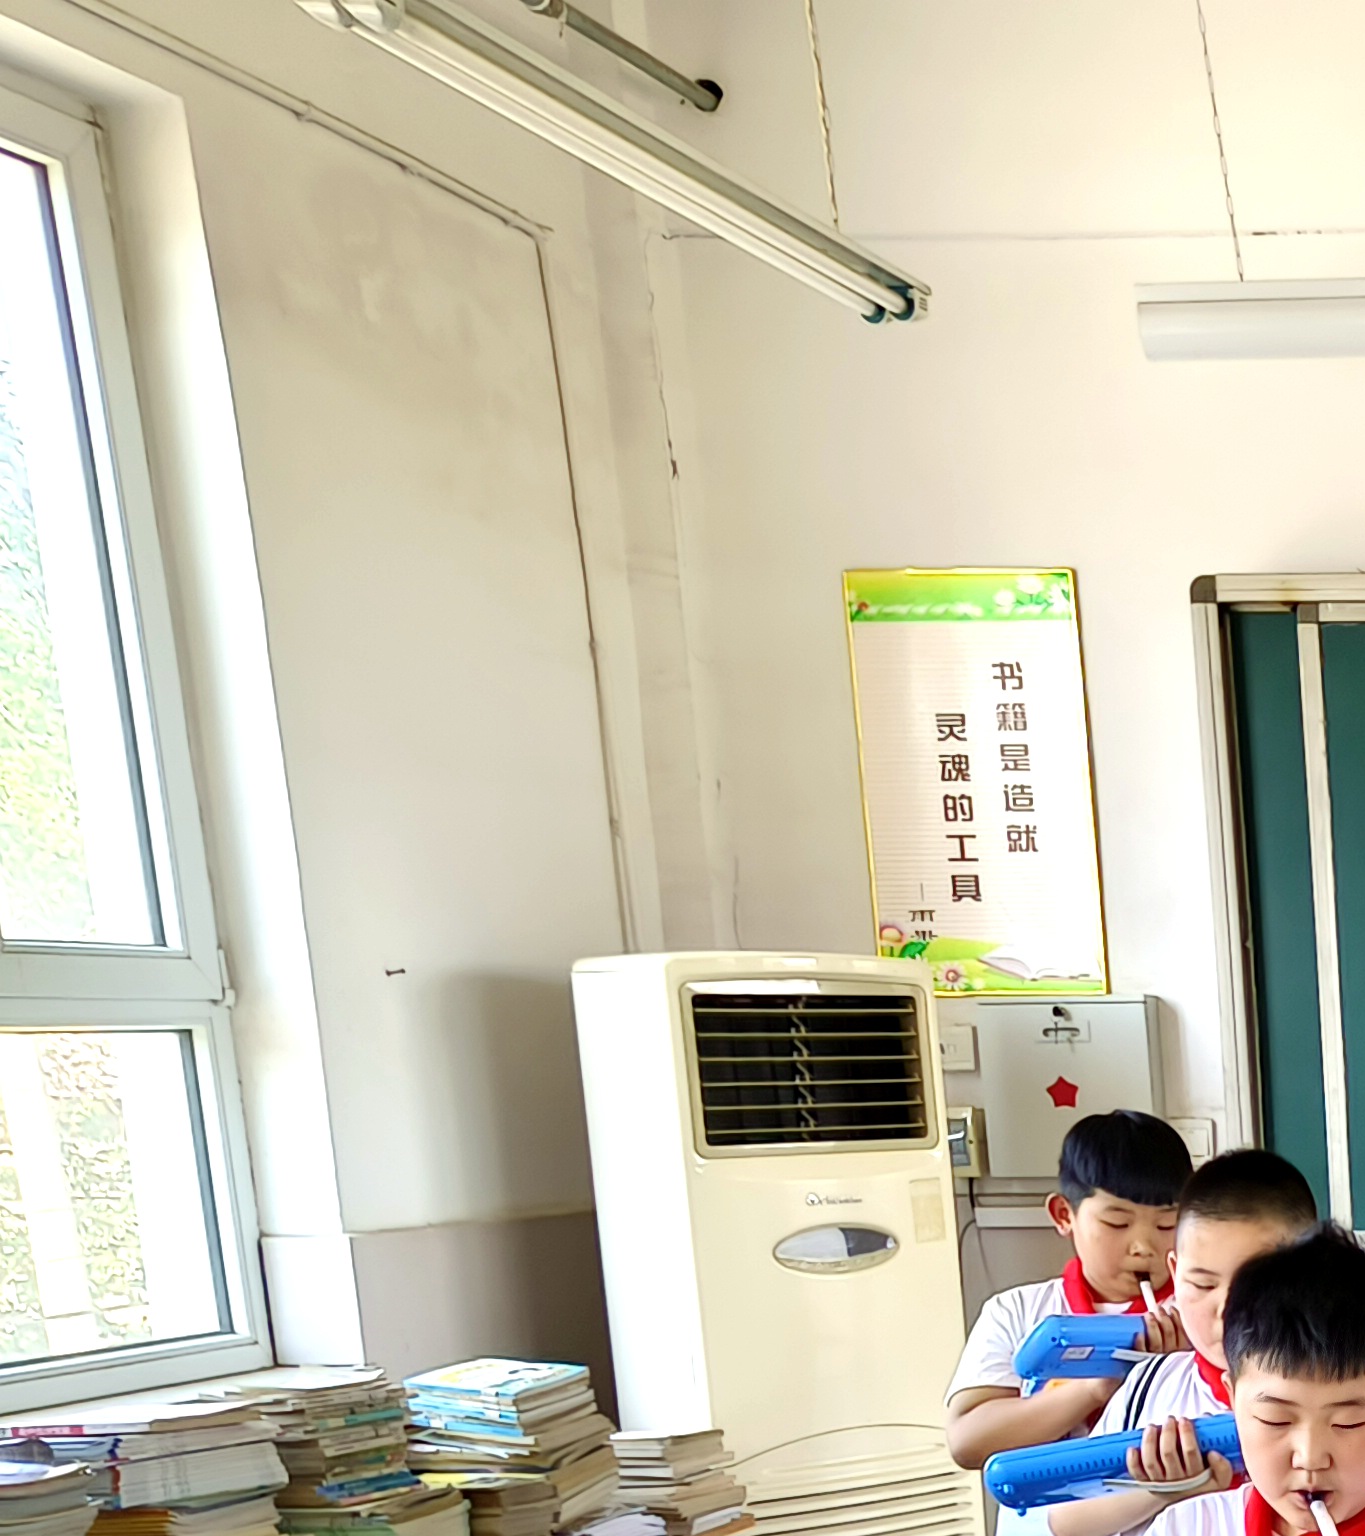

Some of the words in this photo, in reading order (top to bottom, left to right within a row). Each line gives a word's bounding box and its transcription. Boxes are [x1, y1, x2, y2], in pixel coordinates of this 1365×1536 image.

[935, 713, 982, 903] 灵魂的工具
[992, 661, 1039, 853] 书籍是造就
